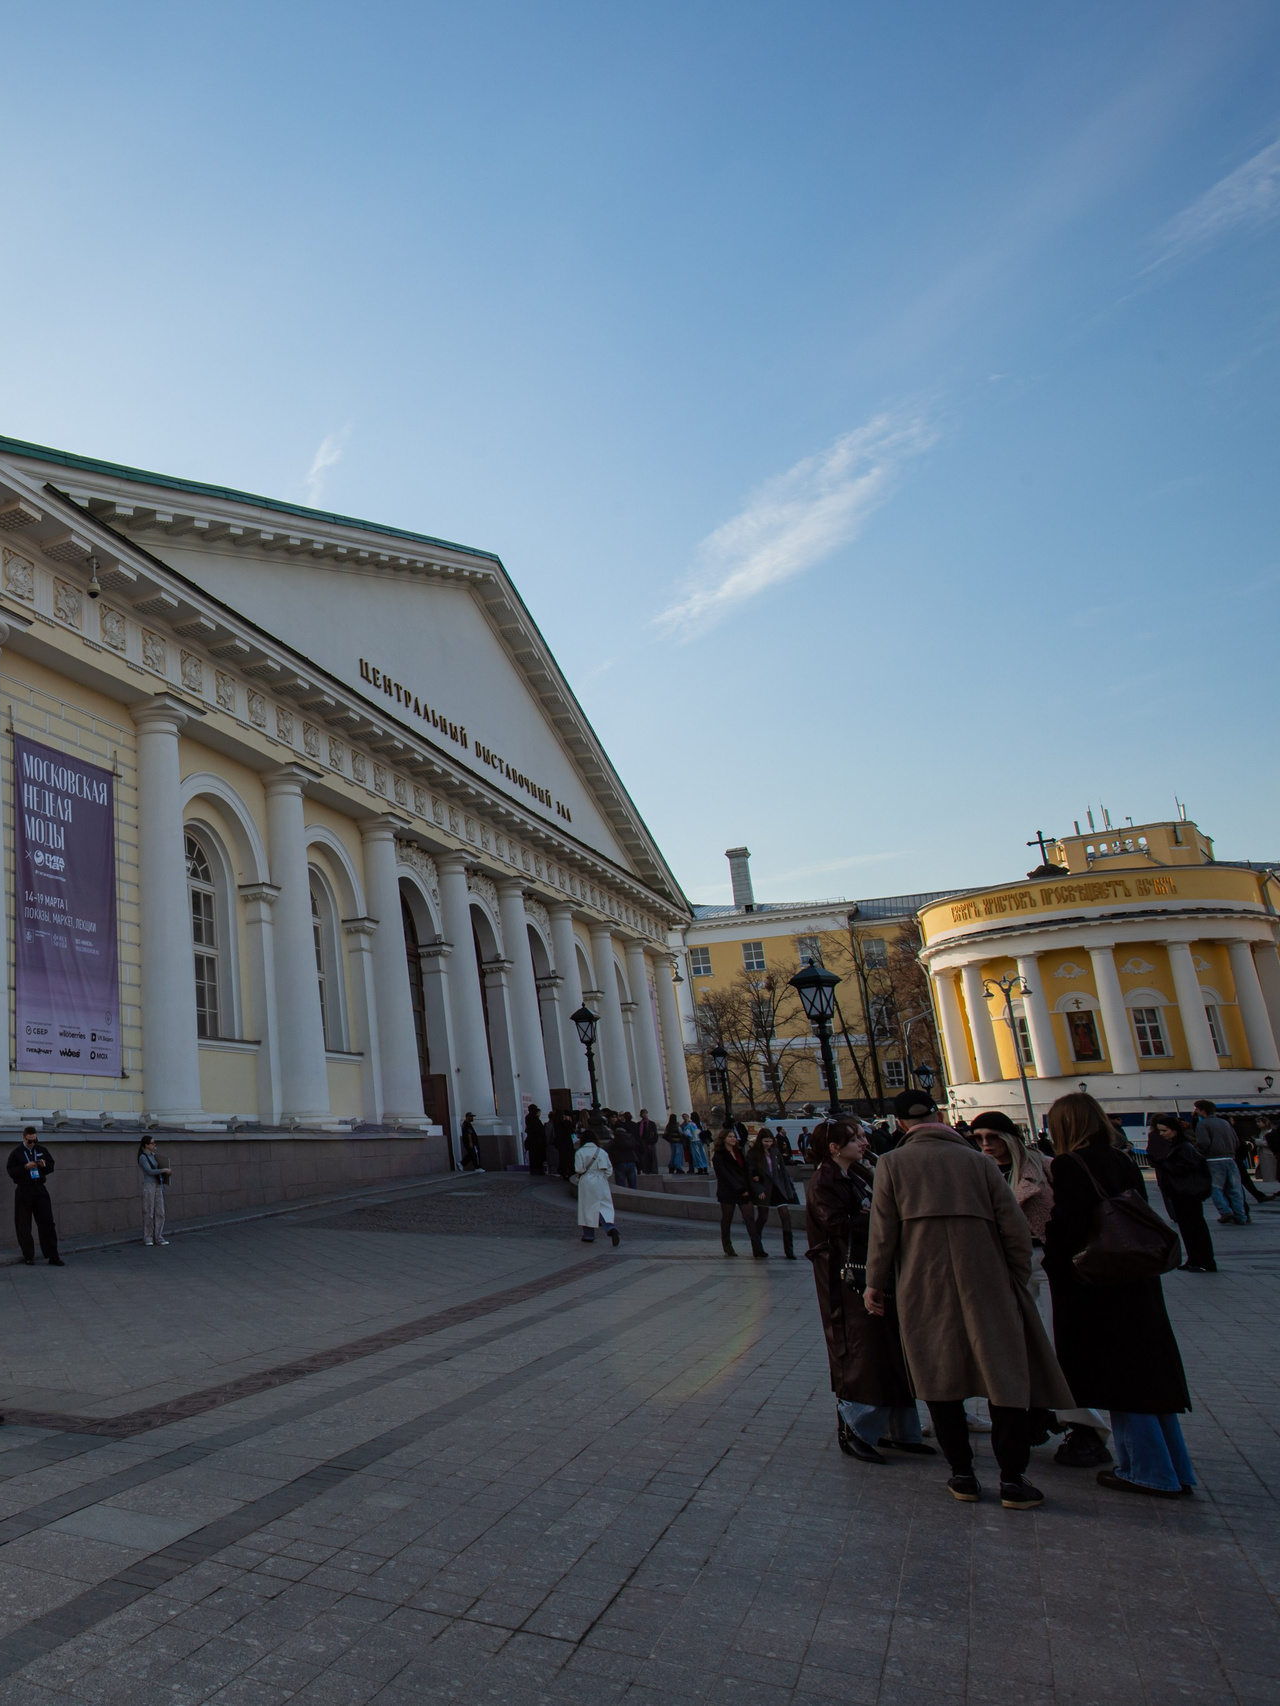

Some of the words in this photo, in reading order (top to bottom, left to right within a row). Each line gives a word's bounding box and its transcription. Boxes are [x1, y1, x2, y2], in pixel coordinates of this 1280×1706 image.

[359, 657, 469, 749] ЦЕНТРАЛЬНЫЙ
[475, 740, 552, 809] ВЫСТАВОЧНЫЙ
[556, 801, 572, 823] ЗАЛ
[23, 752, 108, 806] МОСКОВСКАЯ
[24, 782, 72, 823] НЕДЕЛЯ
[24, 813, 65, 850] МОДЫ
[44, 895, 65, 910] МАРТА
[32, 1027, 49, 1036] СБЕР
